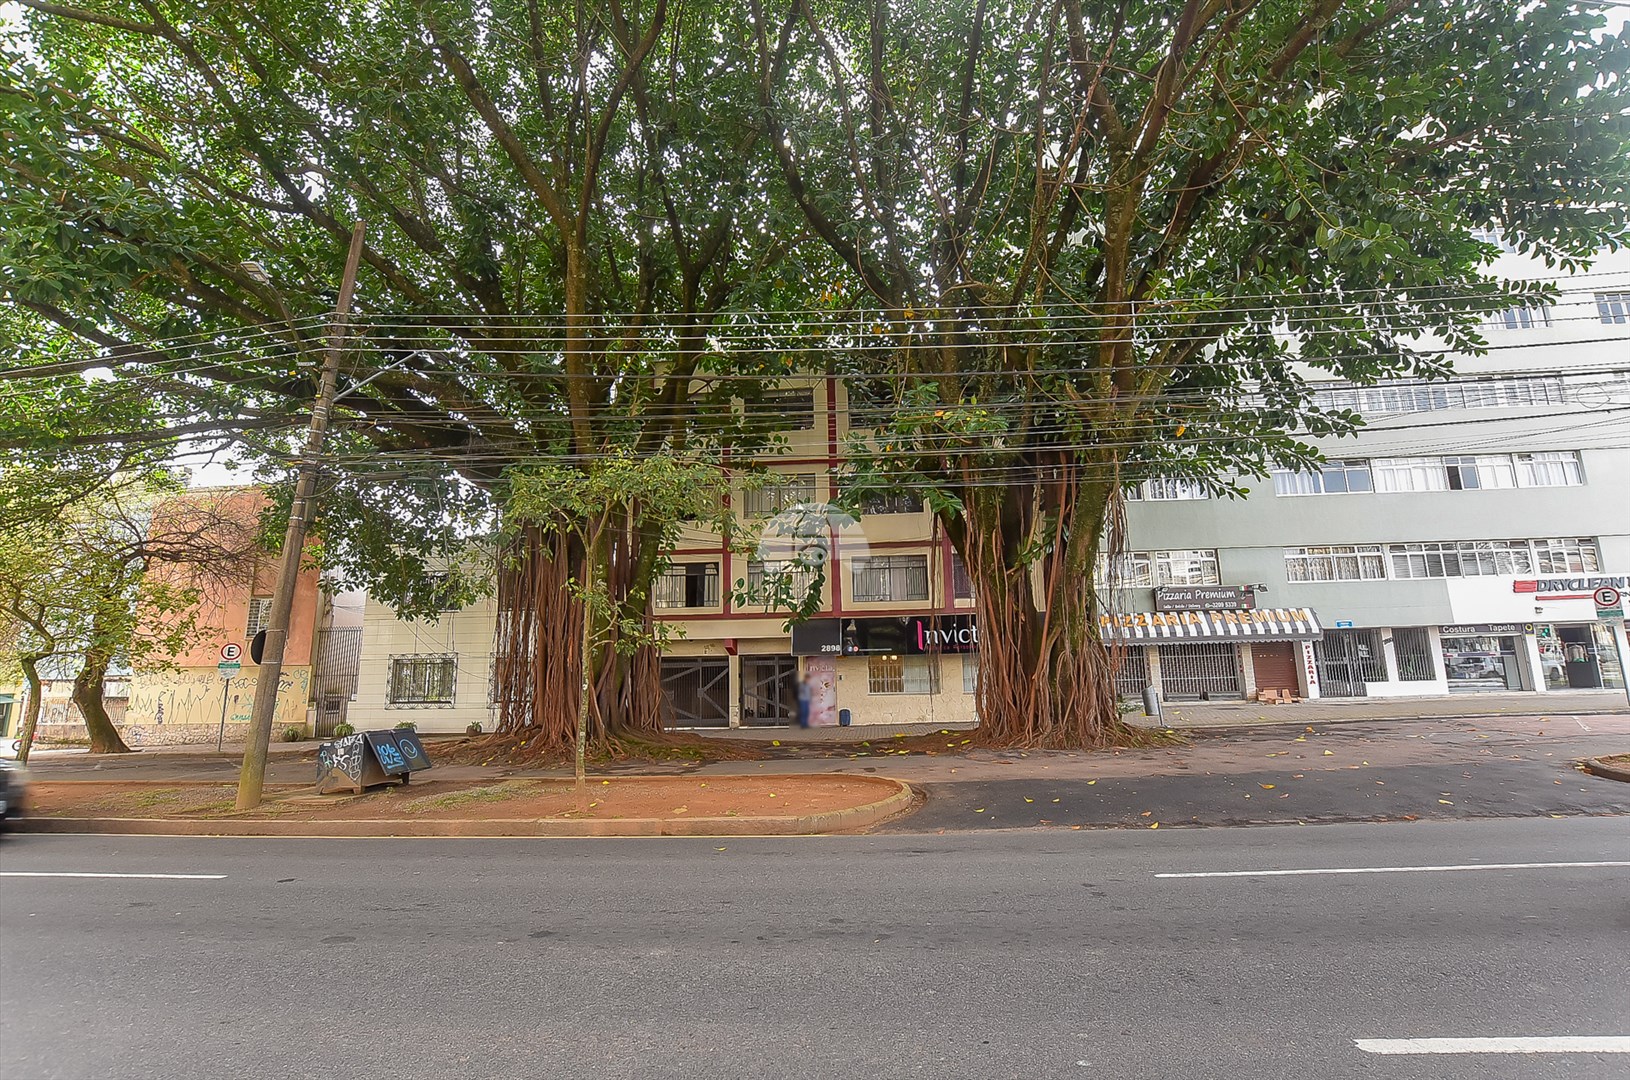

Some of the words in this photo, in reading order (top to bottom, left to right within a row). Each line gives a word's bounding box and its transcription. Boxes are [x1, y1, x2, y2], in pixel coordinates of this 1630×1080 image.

[1536, 577, 1625, 592] DRYCLEAN
[1157, 589, 1192, 601] Pizzaria
[1195, 588, 1236, 600] Premium
[1601, 591, 1612, 602] E
[1100, 612, 1203, 628] PIZZARIA
[1210, 609, 1308, 625] PREMIUM
[916, 620, 978, 650] Invict
[1442, 625, 1476, 633] Costura
[1488, 624, 1516, 632] Tapete
[227, 646, 236, 657] E
[1305, 644, 1316, 685] PIZZARIA
